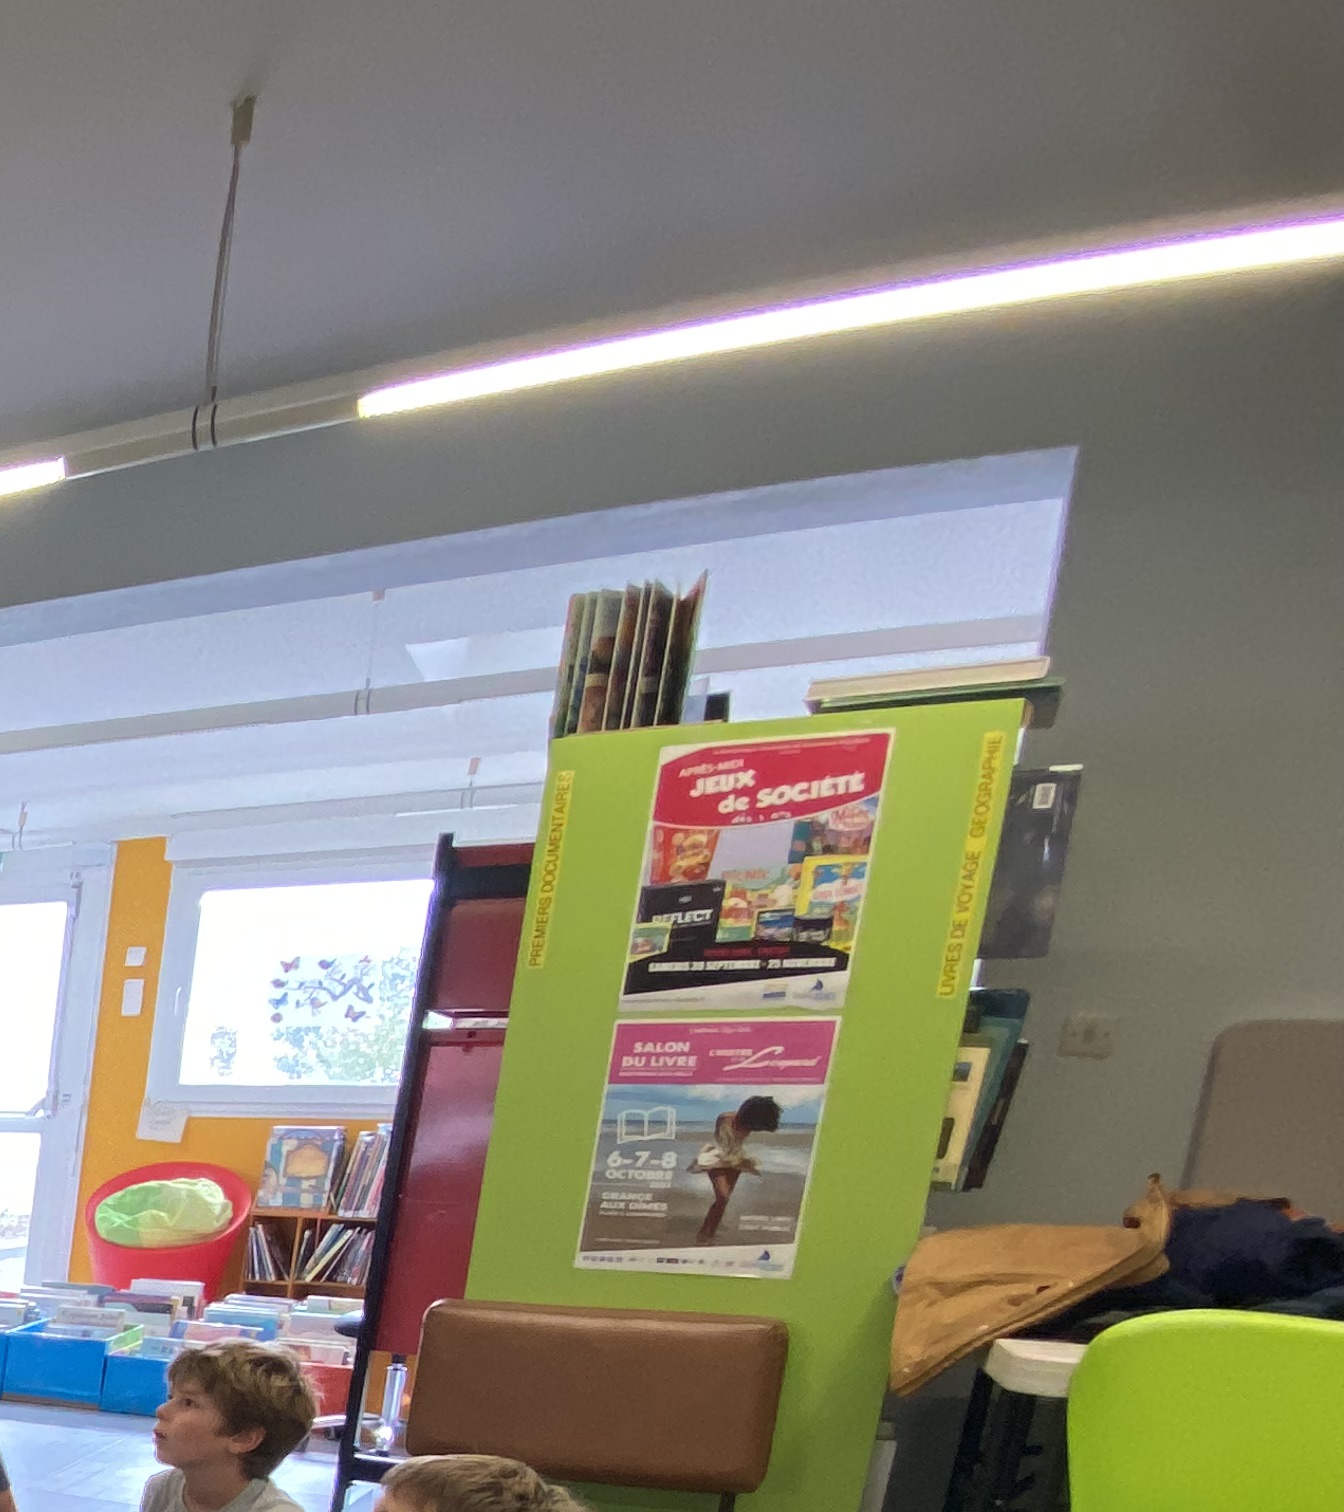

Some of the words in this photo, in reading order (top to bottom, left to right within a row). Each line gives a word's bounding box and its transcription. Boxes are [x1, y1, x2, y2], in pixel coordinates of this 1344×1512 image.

[690, 769, 756, 797] JEUX
[718, 795, 749, 814] de
[756, 771, 865, 808] SOCIÉTÉ
[969, 735, 1004, 839] GEOGRAPHIE
[540, 771, 572, 895] DOCUMENTAIRES
[958, 850, 981, 917] VOYAGE
[528, 896, 553, 967] PREMIERS
[950, 919, 968, 940] DE
[940, 943, 963, 997] LIVRES
[622, 1055, 646, 1068] DU
[650, 1055, 698, 1068] LIVRE
[633, 1041, 691, 1053] SALON
[606, 1151, 678, 1169] 6-7-8
